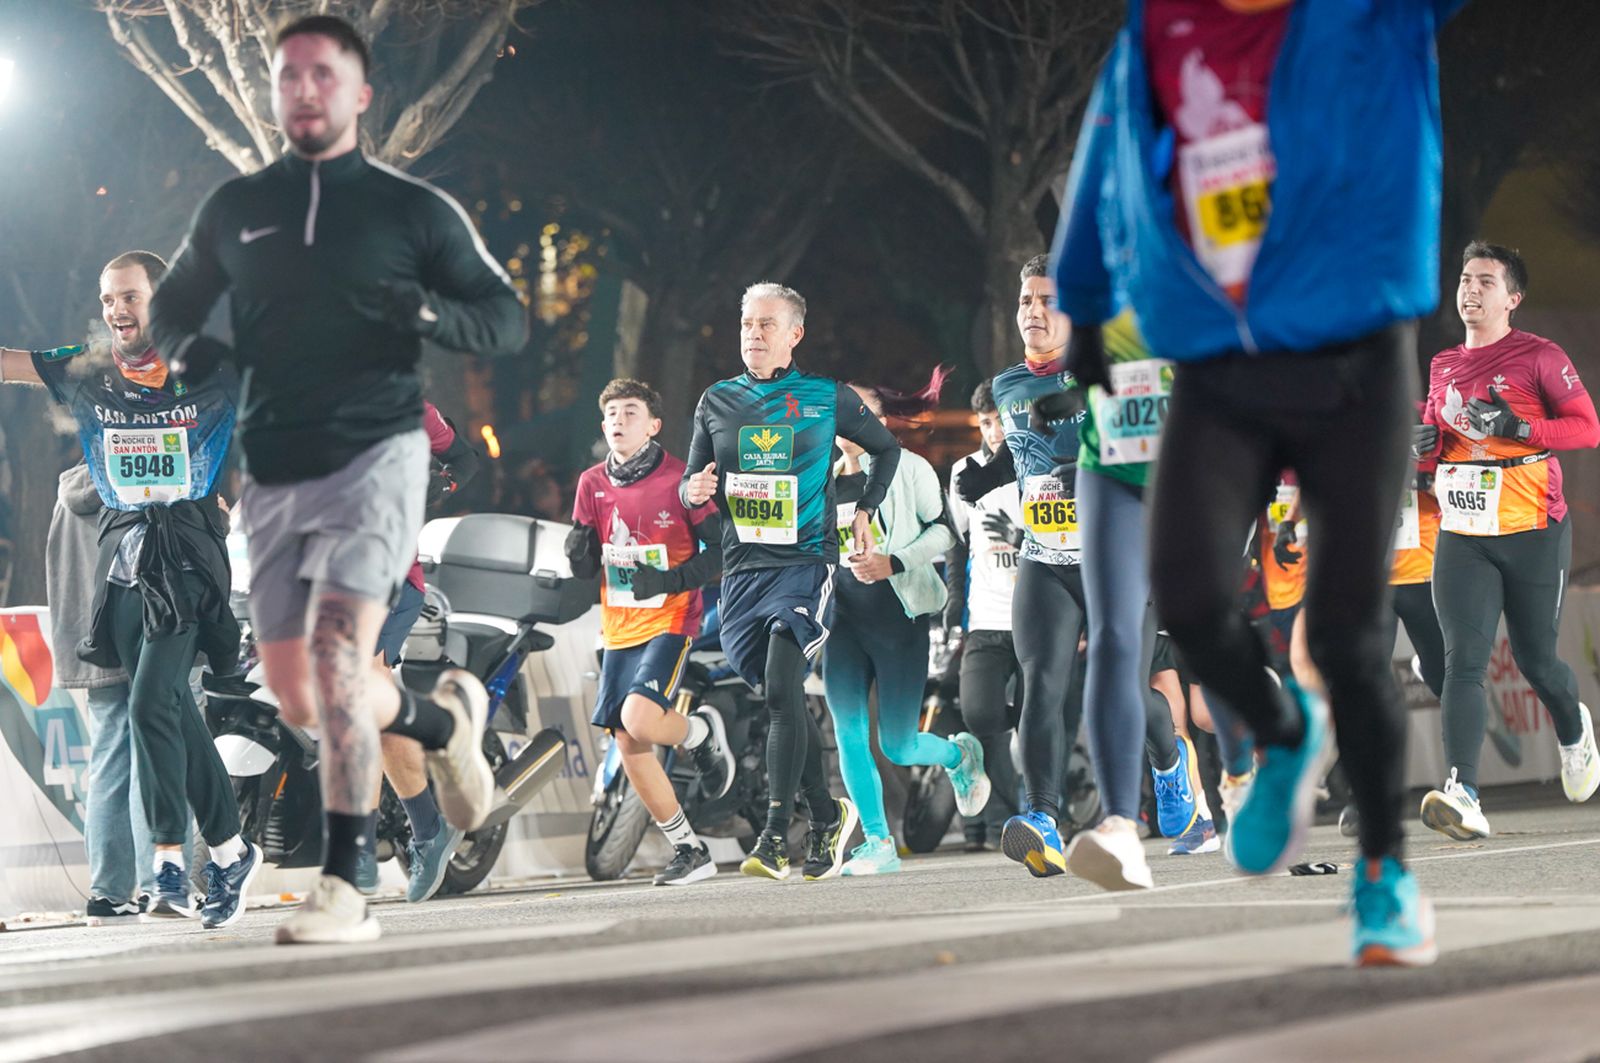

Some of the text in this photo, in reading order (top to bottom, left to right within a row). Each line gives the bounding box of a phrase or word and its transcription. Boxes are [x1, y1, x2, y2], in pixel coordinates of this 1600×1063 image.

[94, 404, 127, 424] SAN
[132, 403, 198, 425] ANTÓN
[1454, 412, 1471, 432] 43
[113, 446, 130, 455] SAN
[121, 437, 146, 445] NOCHE
[147, 436, 156, 444] DE
[120, 454, 175, 478] 5948
[743, 452, 788, 461] CAJA RURAL
[760, 482, 769, 490] DE
[1029, 493, 1045, 502] SN
[1447, 489, 1487, 512] 4695
[735, 498, 784, 521] 8694
[1029, 501, 1077, 525] 1363
